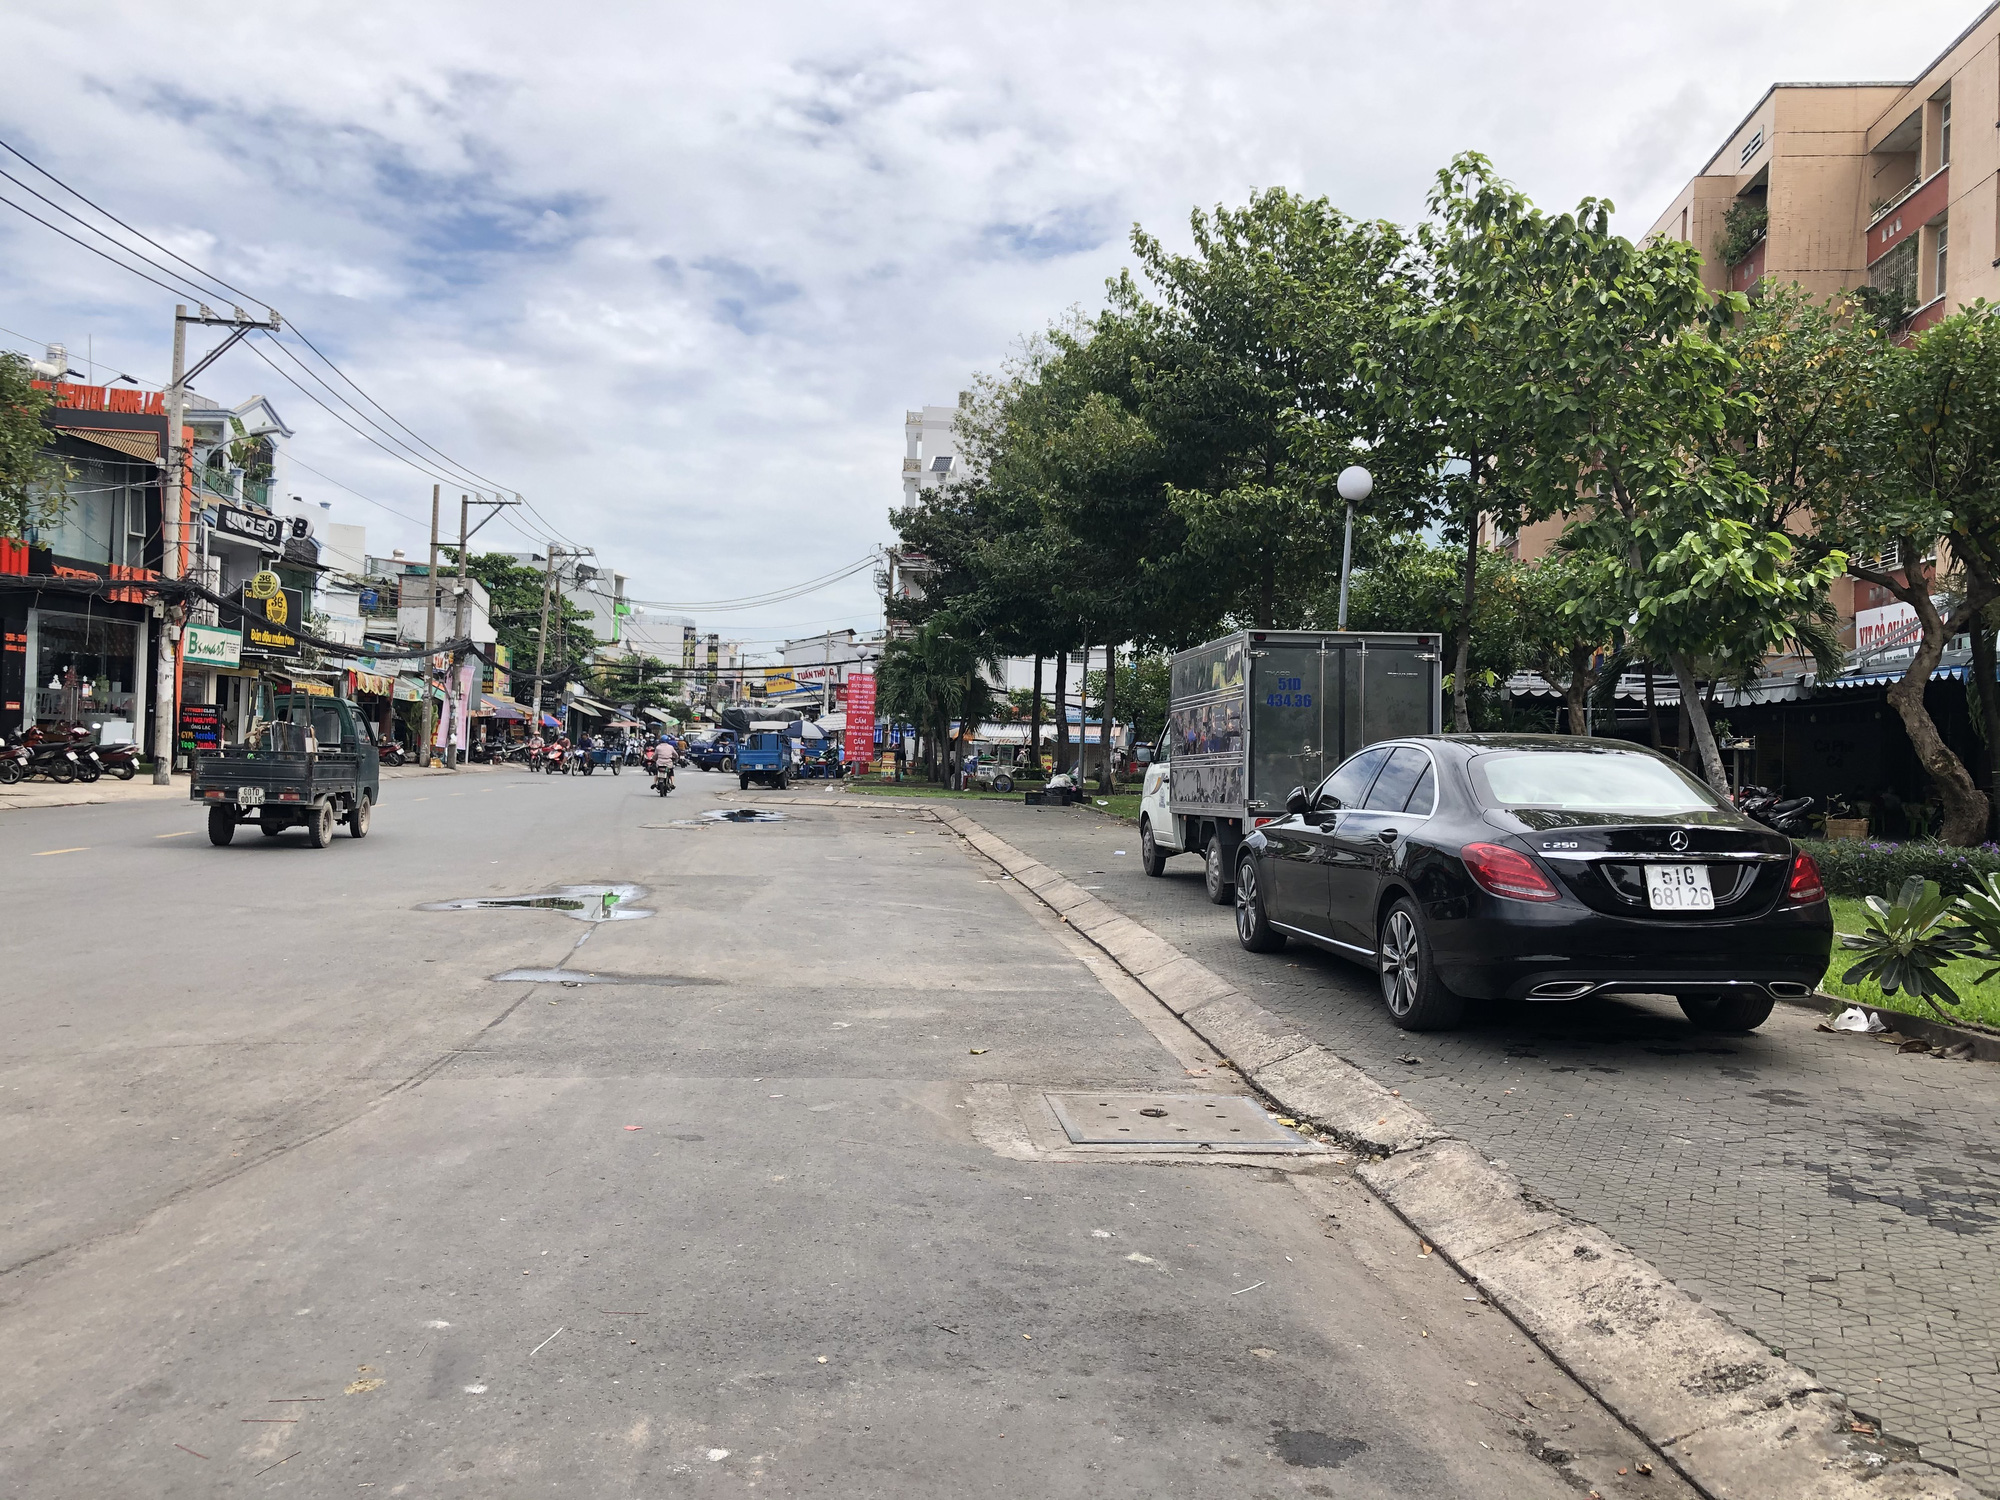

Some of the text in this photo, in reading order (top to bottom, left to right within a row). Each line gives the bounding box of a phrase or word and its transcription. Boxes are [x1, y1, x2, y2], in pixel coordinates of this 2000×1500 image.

[292, 517, 308, 538] B
[271, 597, 283, 608] 36
[814, 667, 835, 677] THÔG
[1278, 677, 1301, 691] 51D
[1266, 694, 1313, 708] 434.36
[1662, 866, 1695, 886] 51G
[1652, 887, 1711, 906] 681.26
